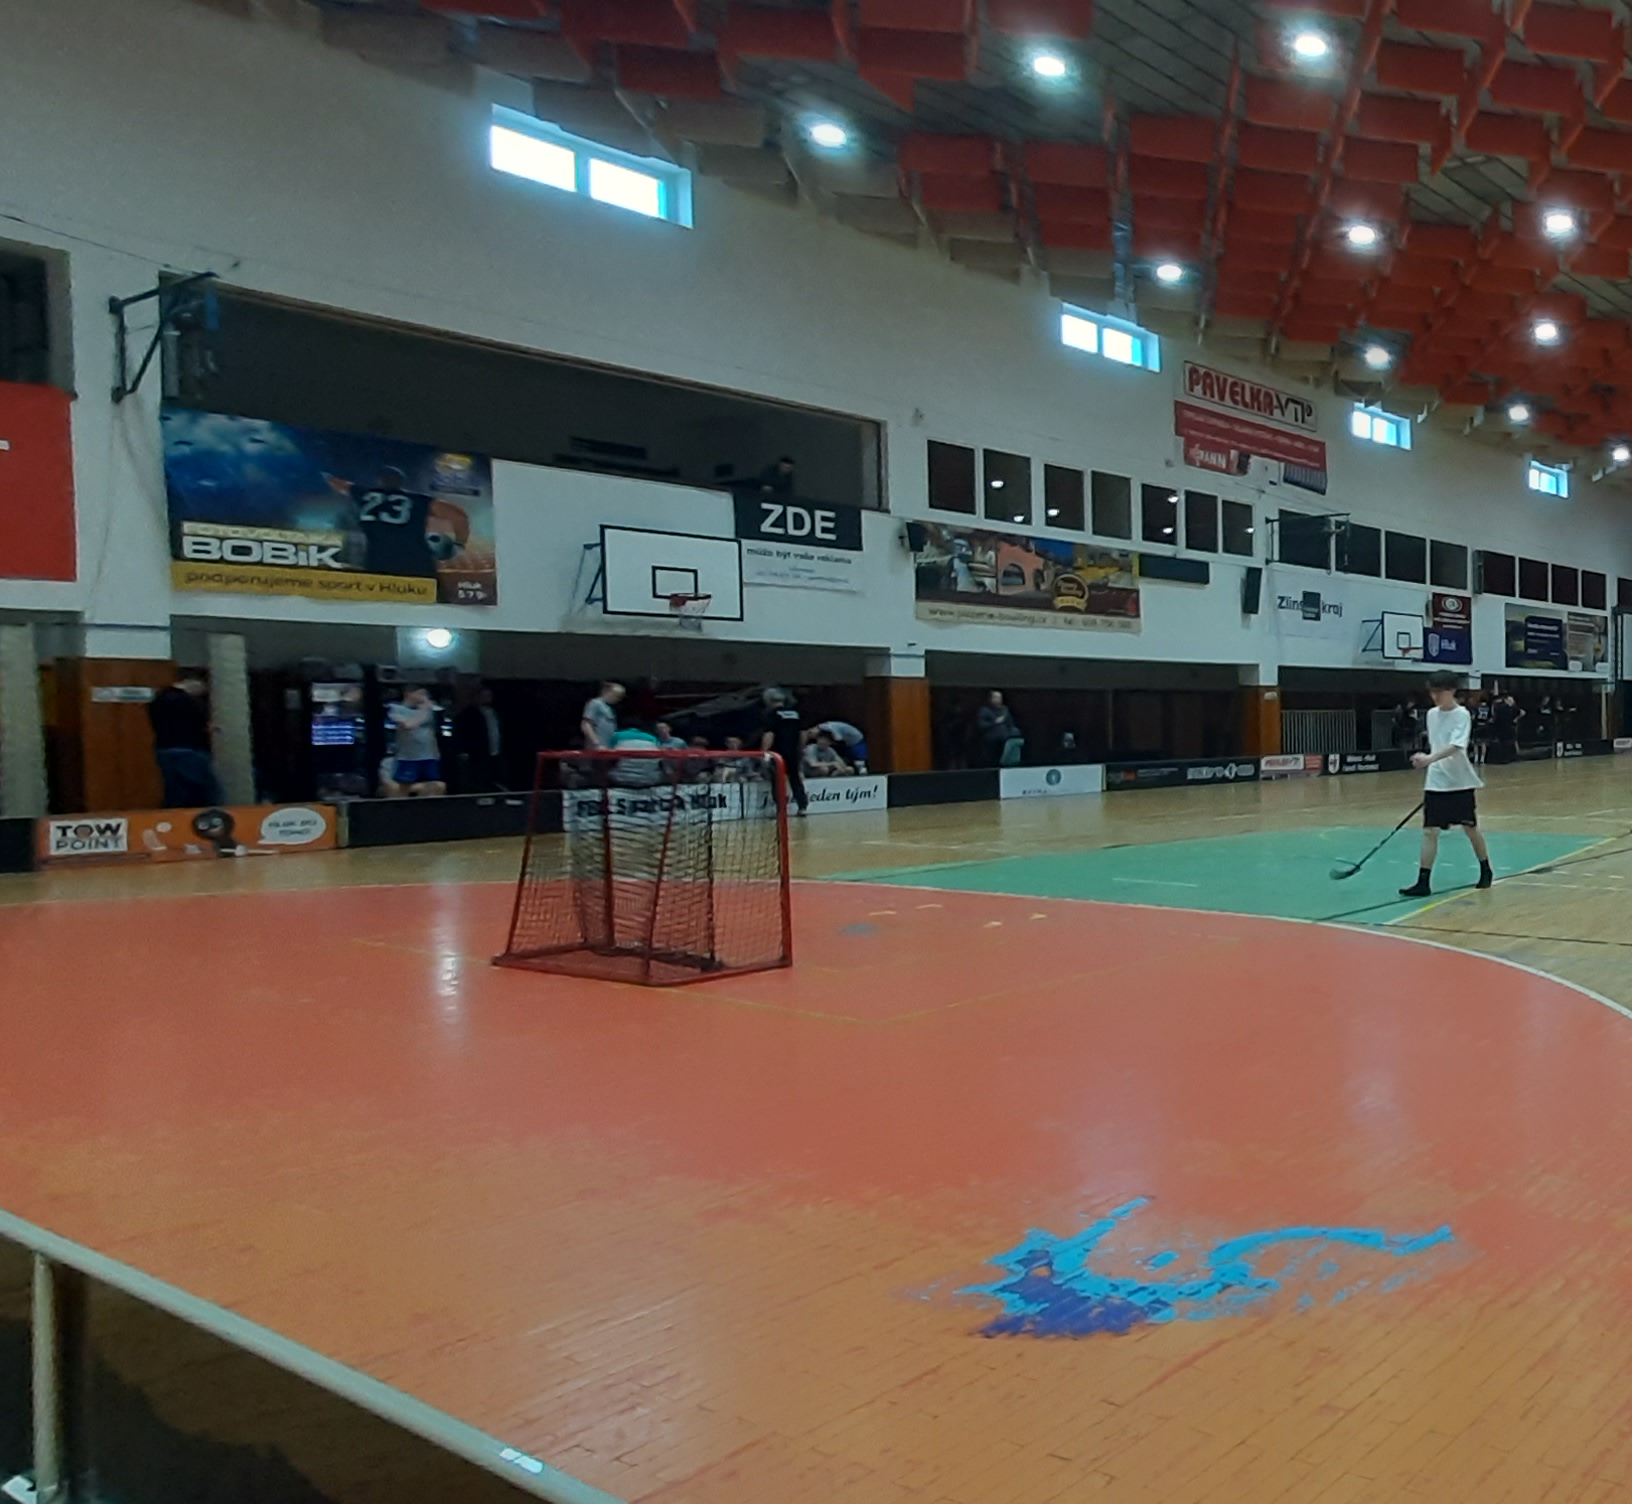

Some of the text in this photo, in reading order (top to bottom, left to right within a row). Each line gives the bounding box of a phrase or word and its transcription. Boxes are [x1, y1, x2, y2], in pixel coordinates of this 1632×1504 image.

[359, 491, 412, 525] 23
[760, 502, 837, 540] ZDE
[318, 578, 362, 592] sport
[368, 582, 377, 592] v
[1321, 600, 1343, 618] kraj
[809, 787, 840, 803] eden
[56, 821, 121, 838] TOW
[56, 836, 121, 851] POINT
